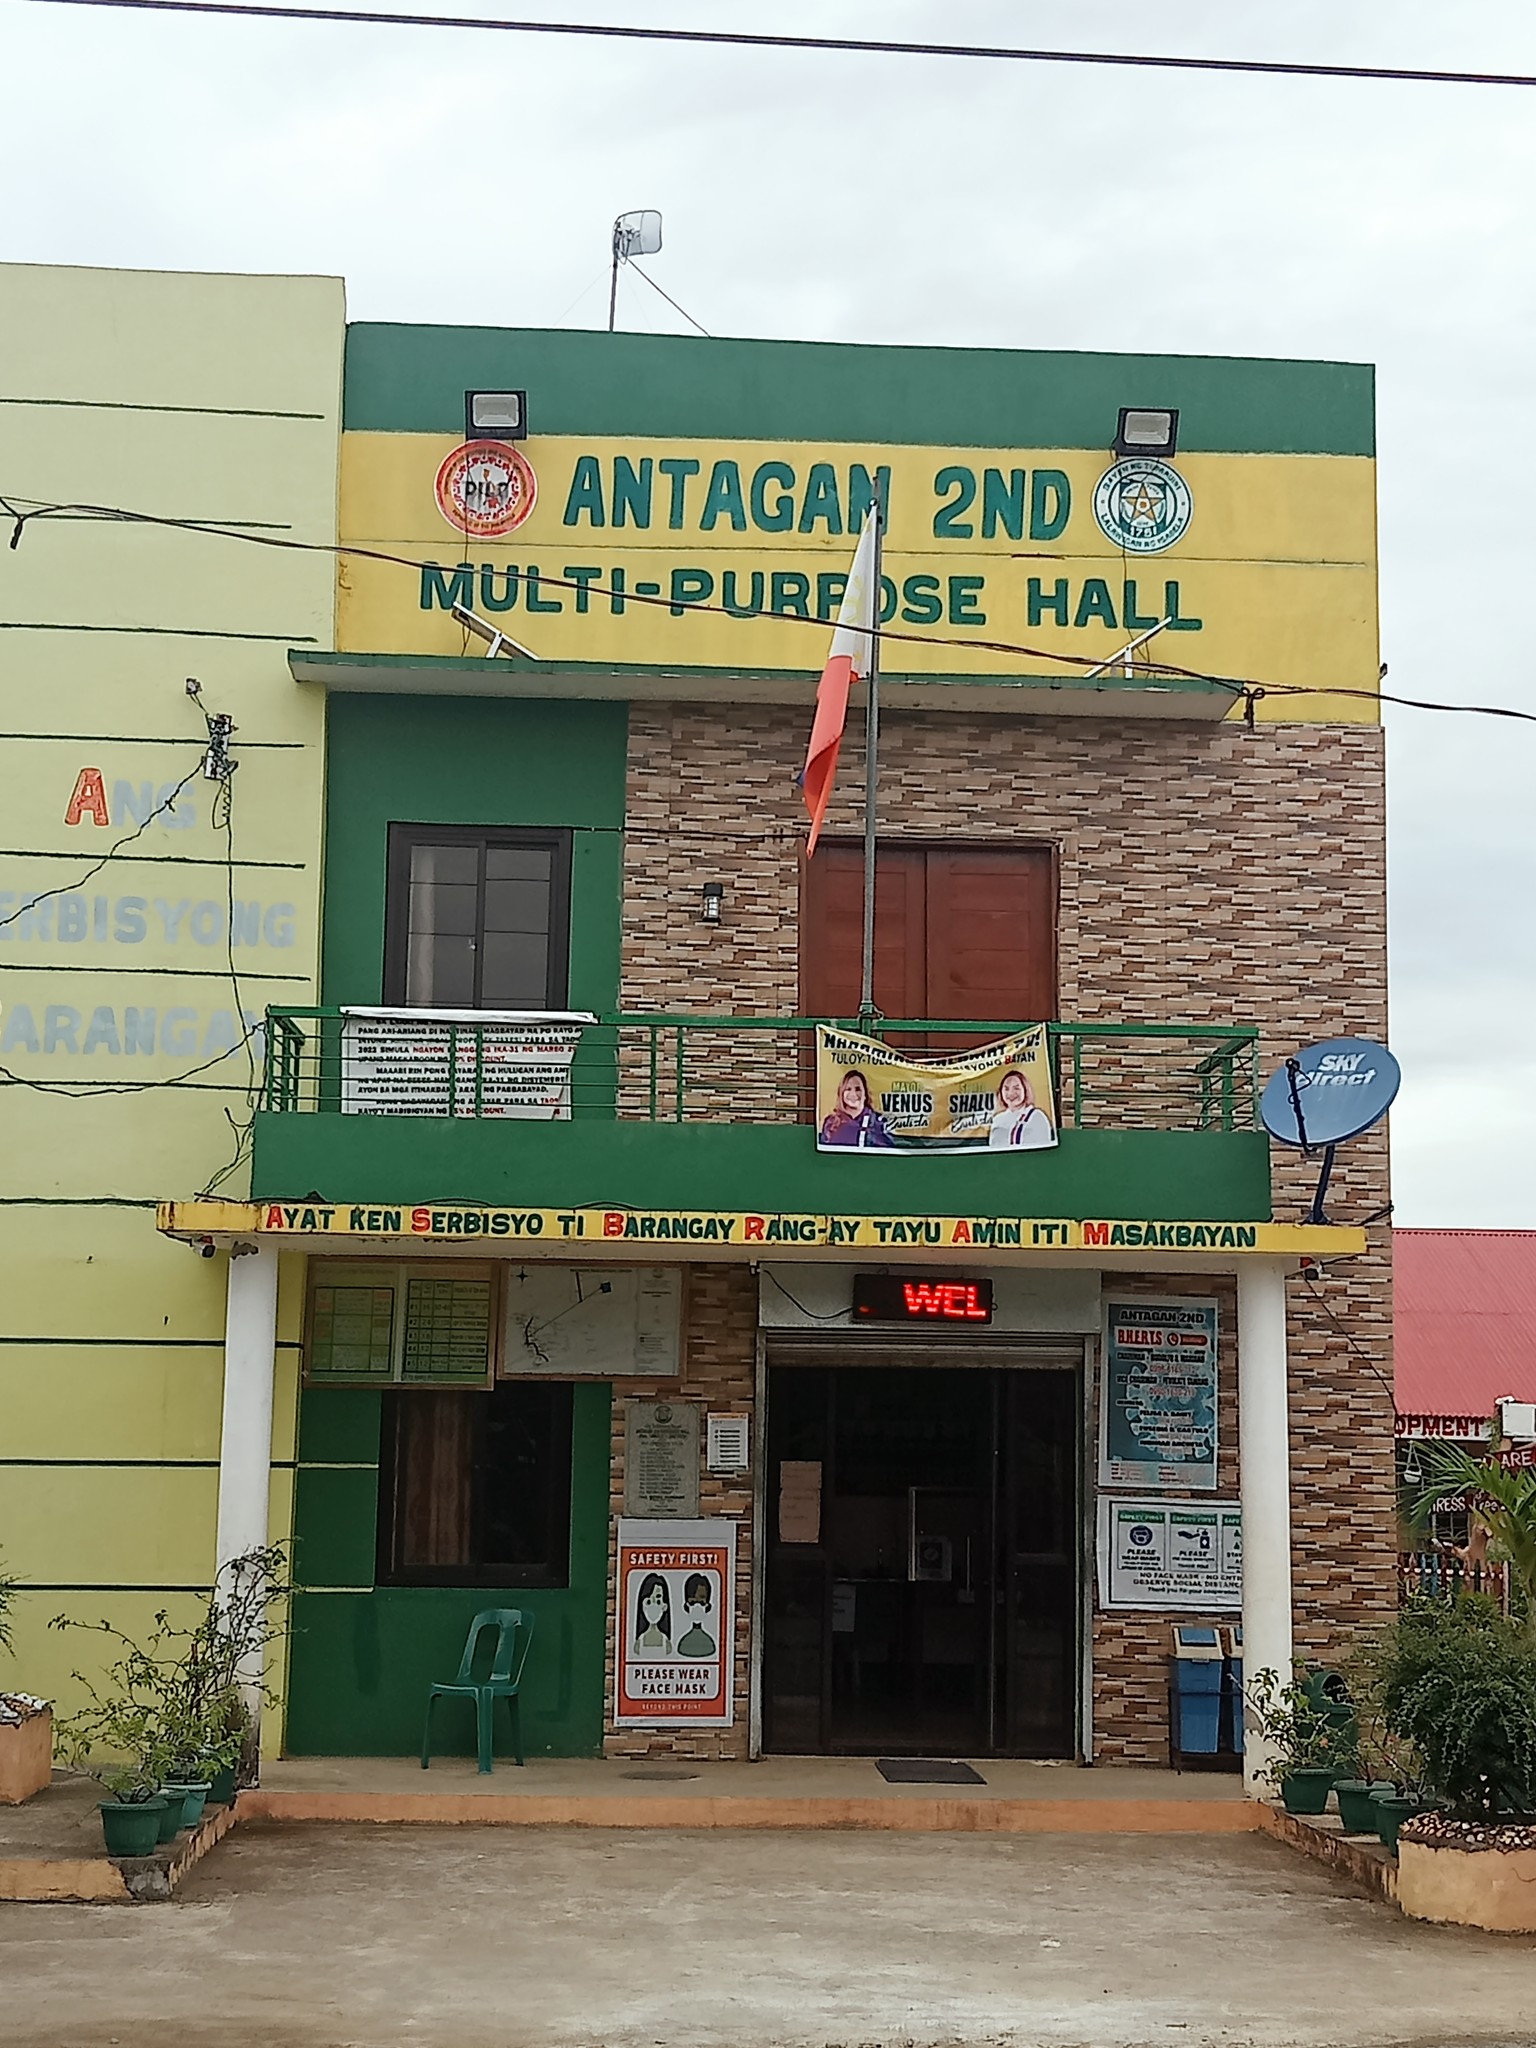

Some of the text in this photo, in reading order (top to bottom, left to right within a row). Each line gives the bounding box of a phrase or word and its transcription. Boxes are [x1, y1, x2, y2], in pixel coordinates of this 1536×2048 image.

[564, 456, 889, 535] ANTAGAN
[932, 466, 1071, 540] 2ND
[1027, 575, 1201, 631] HALL
[65, 767, 196, 830] ANG
[1318, 1052, 1367, 1072] SKY
[881, 1092, 995, 1113] VENUS SHALU
[265, 1206, 1256, 1248] AYAT KEN SERBISYO TI BARANGAY RANG-AY TAYU AMIN ITI MASAKBAYAN
[903, 1283, 987, 1316] WEL
[1120, 1310, 1204, 1324] ANTAGAN 2ND
[1501, 1450, 1533, 1469] ARE
[629, 1552, 718, 1566] SAFETY FIRST!
[634, 1668, 710, 1680] PLEASE WEAR
[641, 1683, 706, 1695] FACE MASK
